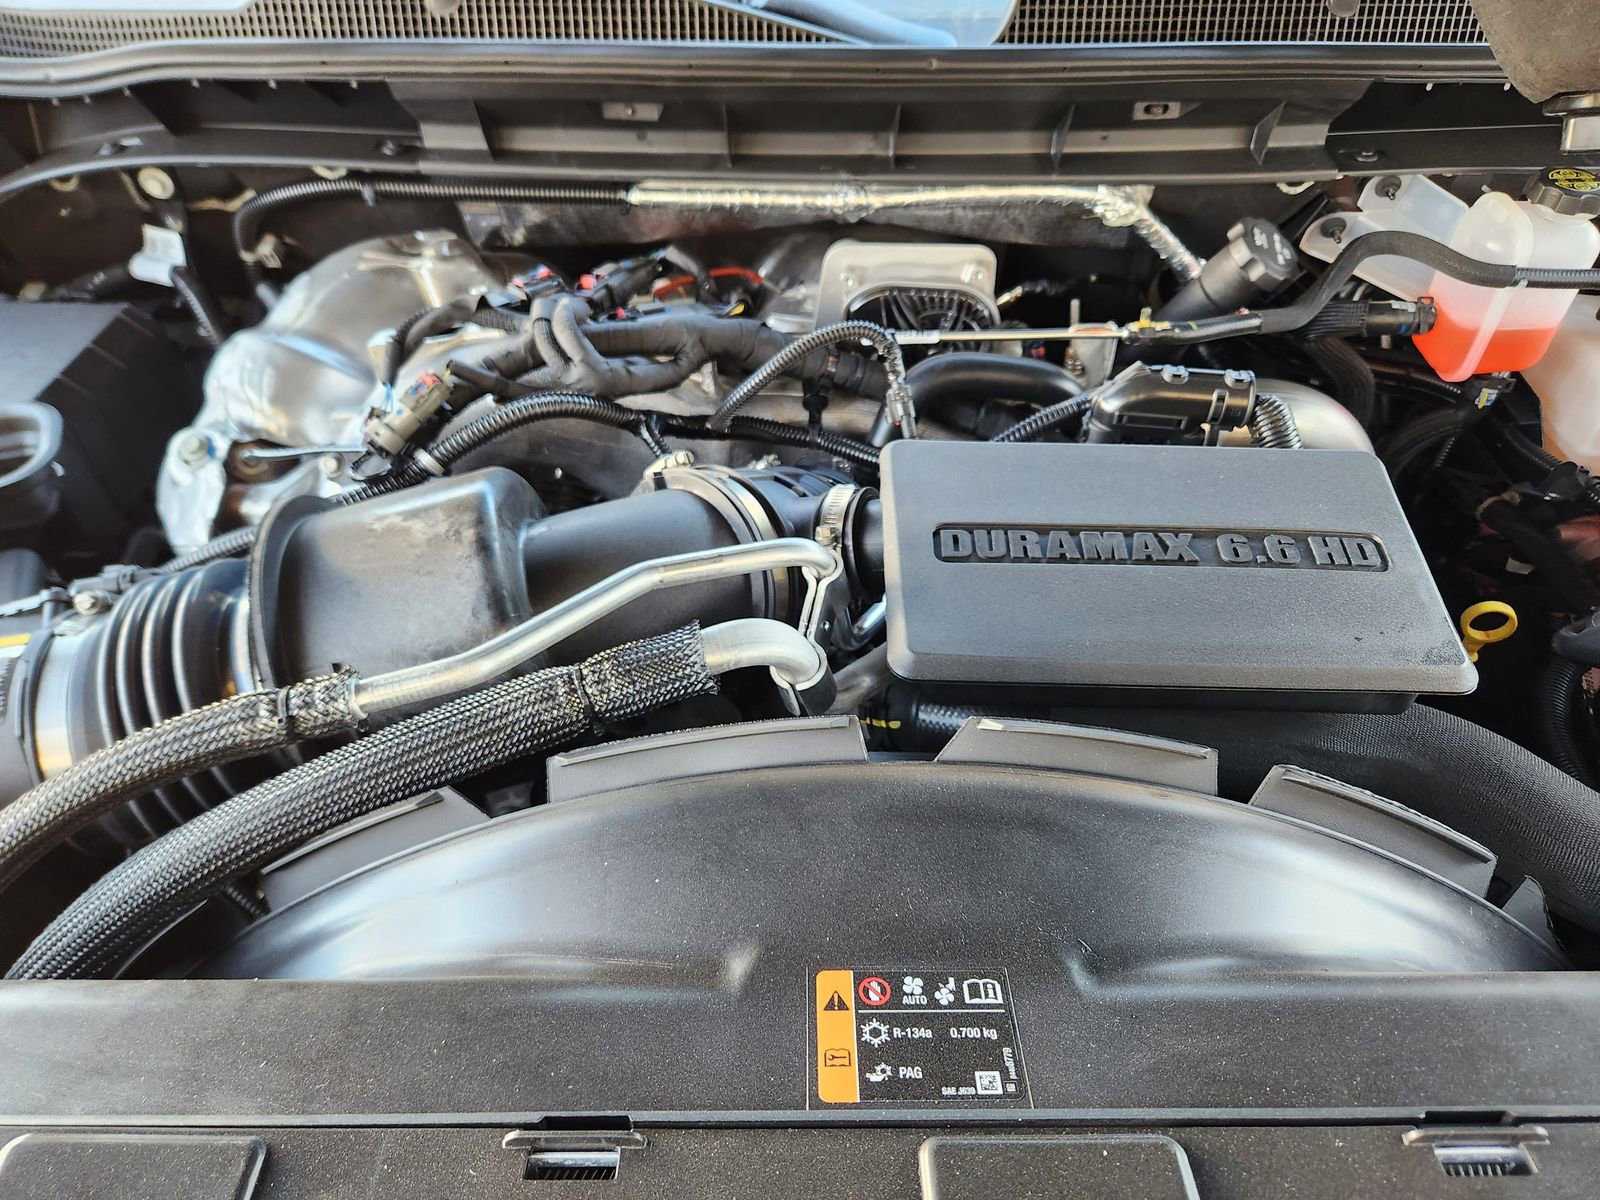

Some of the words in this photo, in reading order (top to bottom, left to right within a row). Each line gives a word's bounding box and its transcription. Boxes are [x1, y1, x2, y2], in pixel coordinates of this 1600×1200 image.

[939, 529, 1199, 562] DURAMAX
[1216, 533, 1300, 565] 6.6
[1308, 535, 1384, 568] HD
[902, 995, 928, 1005] AUTO
[893, 1027, 933, 1039] R-134a
[982, 1027, 998, 1040] kg
[898, 1066, 923, 1079] PAG
[941, 1086, 957, 1096] SAE
